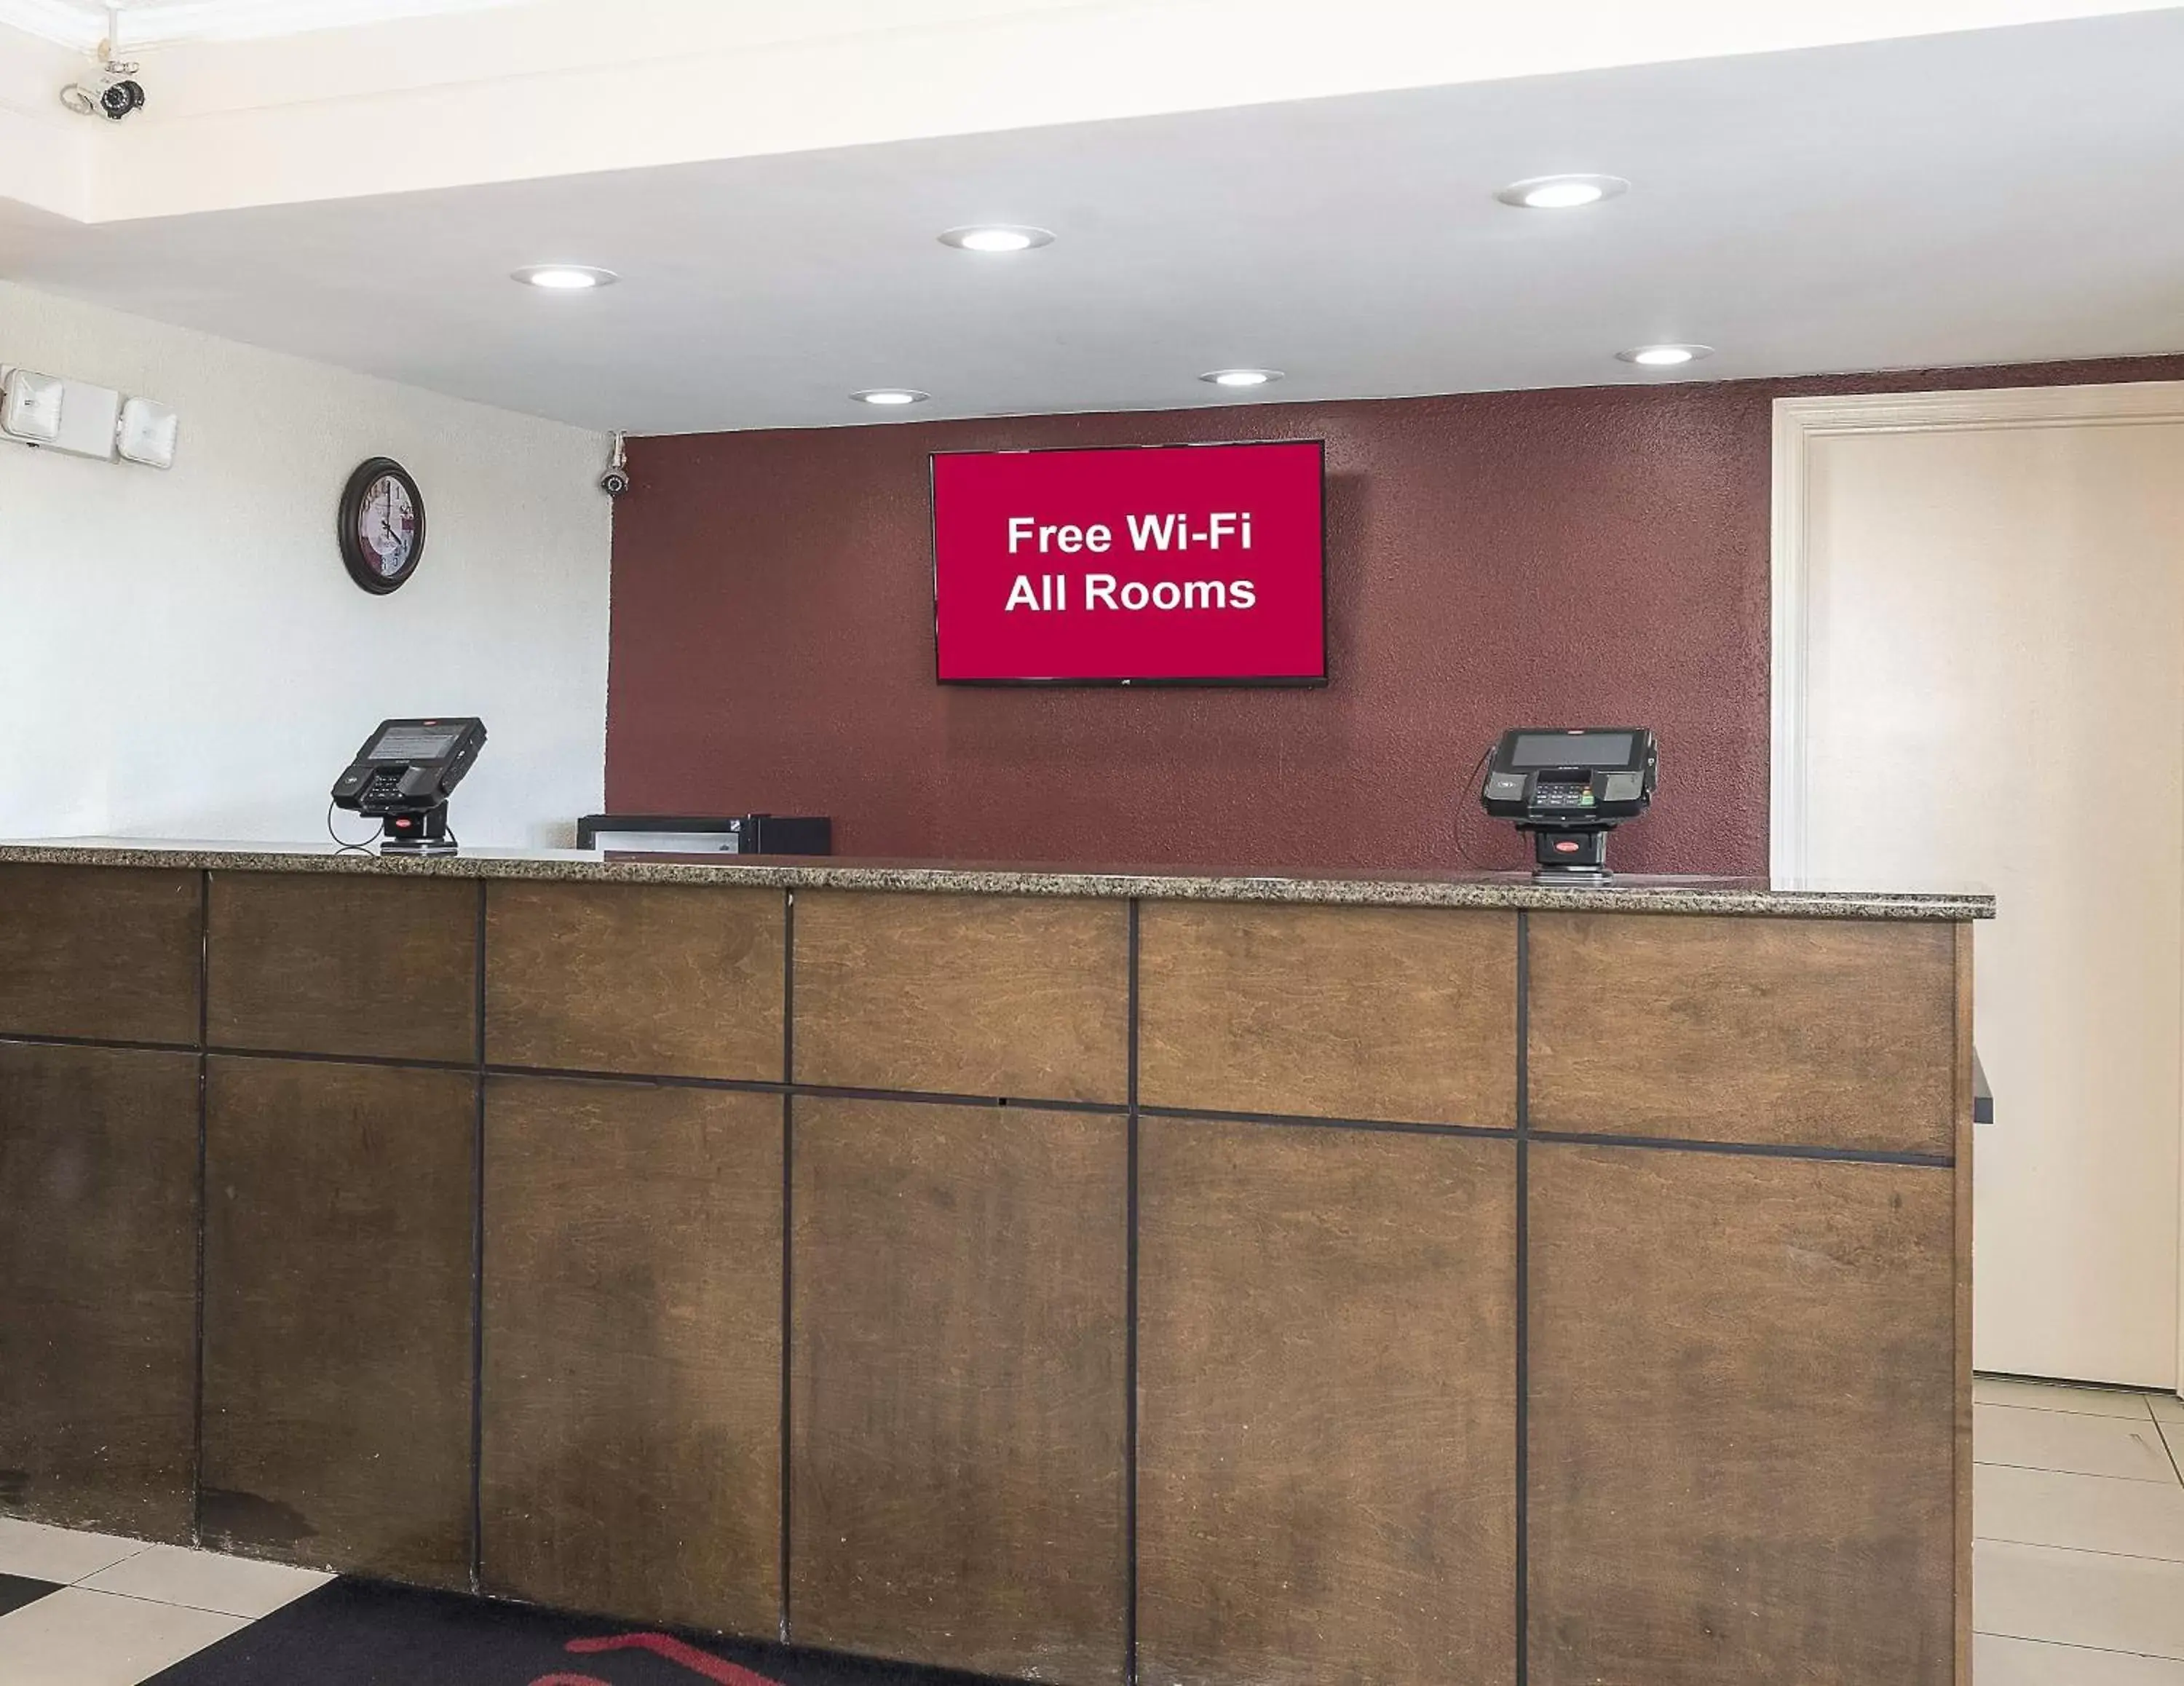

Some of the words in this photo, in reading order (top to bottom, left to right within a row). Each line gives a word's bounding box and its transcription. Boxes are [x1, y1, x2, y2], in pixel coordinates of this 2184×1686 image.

[1008, 517, 1112, 554] Free
[1126, 512, 1252, 551] Wi-Fi
[1005, 574, 1066, 612] All
[1085, 574, 1257, 610] Rooms
